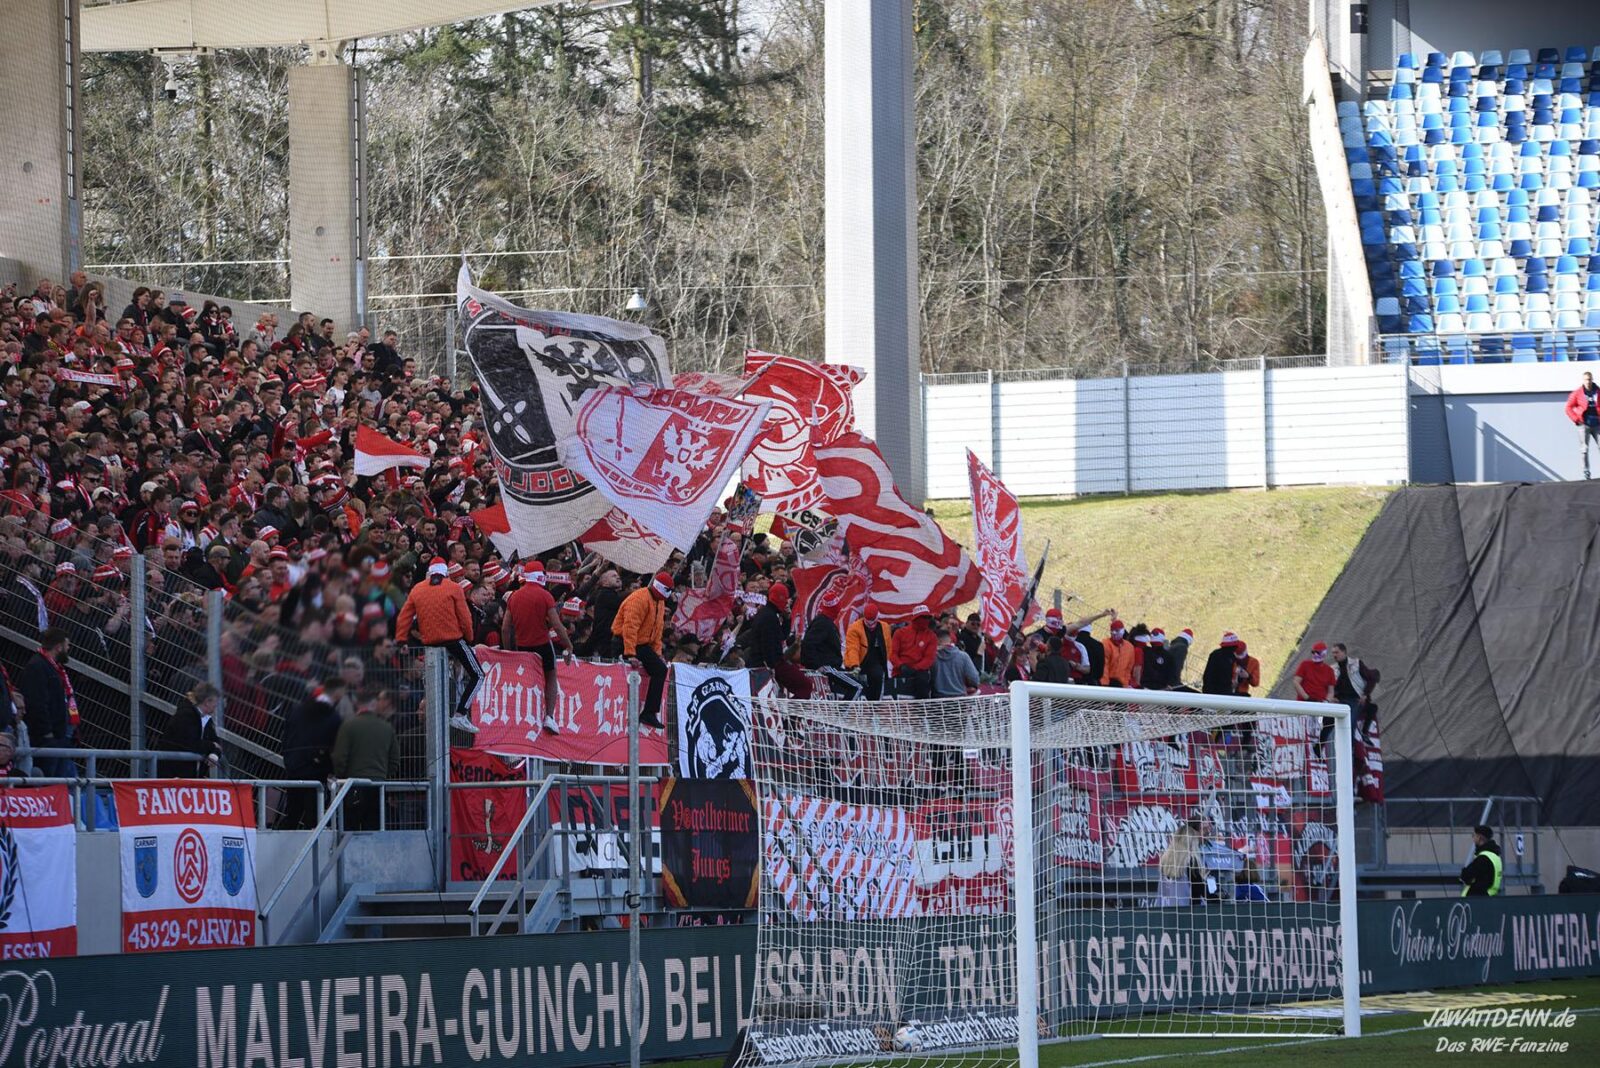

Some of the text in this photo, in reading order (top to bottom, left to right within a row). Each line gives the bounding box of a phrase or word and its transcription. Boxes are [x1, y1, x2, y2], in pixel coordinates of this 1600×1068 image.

[476, 661, 583, 742] Brigde
[136, 788, 232, 816] FANCLUB
[672, 800, 750, 835] Vogelheimer
[136, 838, 157, 848] CARNAP
[223, 838, 243, 848] CARNAP
[691, 848, 731, 884] Jungs
[128, 918, 250, 949] 45329-CARNAP
[1391, 900, 1443, 967] Victor's
[1447, 903, 1506, 983] Portugal
[664, 955, 722, 1043] BEI
[1087, 936, 1128, 1006] SIE
[1135, 932, 1192, 1003] SICH
[1200, 930, 1238, 997] INS
[750, 1026, 828, 1063] Eisenbach
